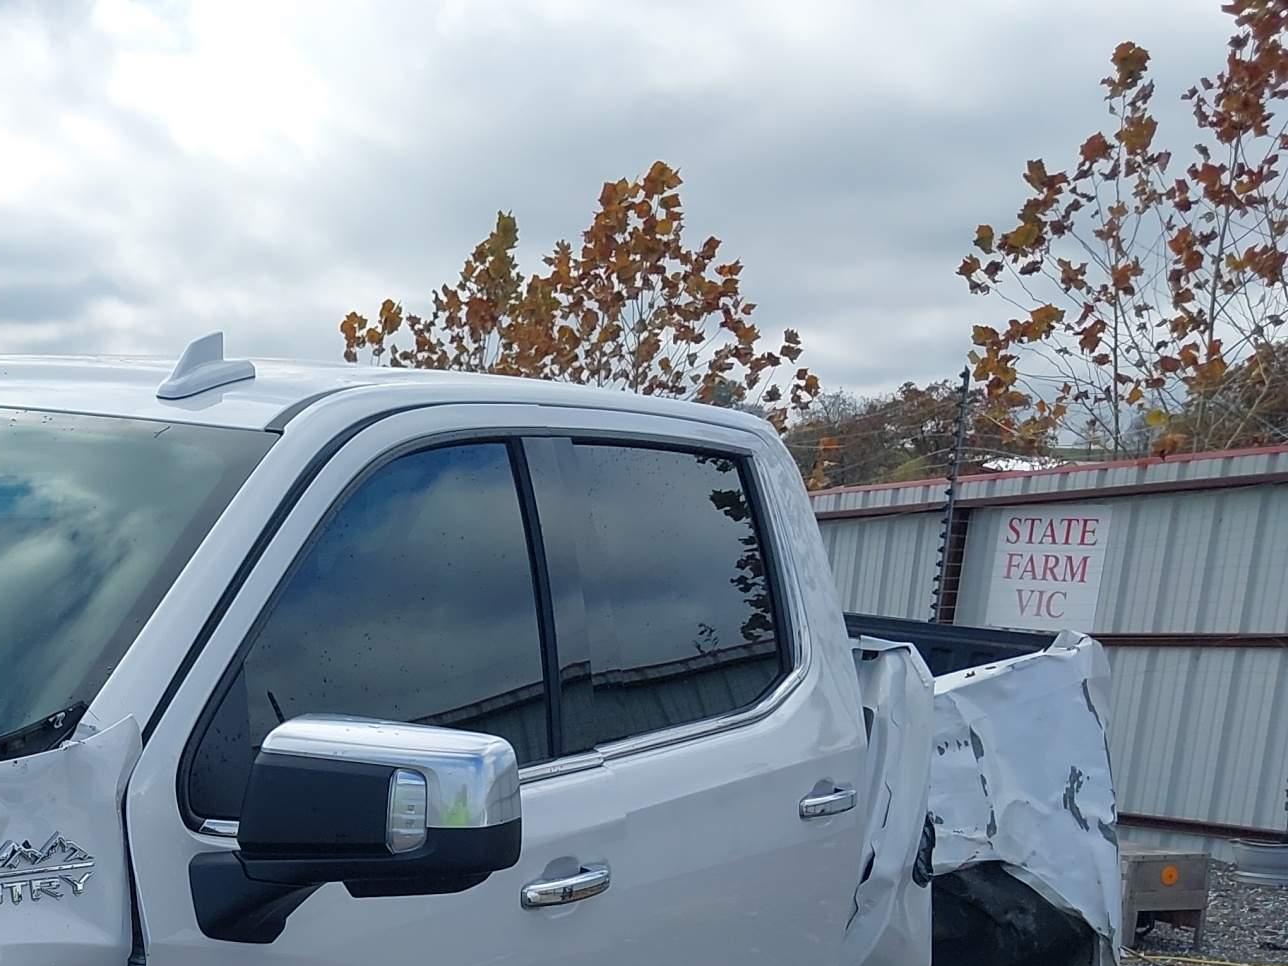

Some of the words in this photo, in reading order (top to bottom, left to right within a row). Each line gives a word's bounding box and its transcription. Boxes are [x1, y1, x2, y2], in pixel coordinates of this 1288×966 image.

[1006, 517, 1099, 546] STATE
[1003, 553, 1090, 583] FARM
[1016, 589, 1067, 618] VIC
